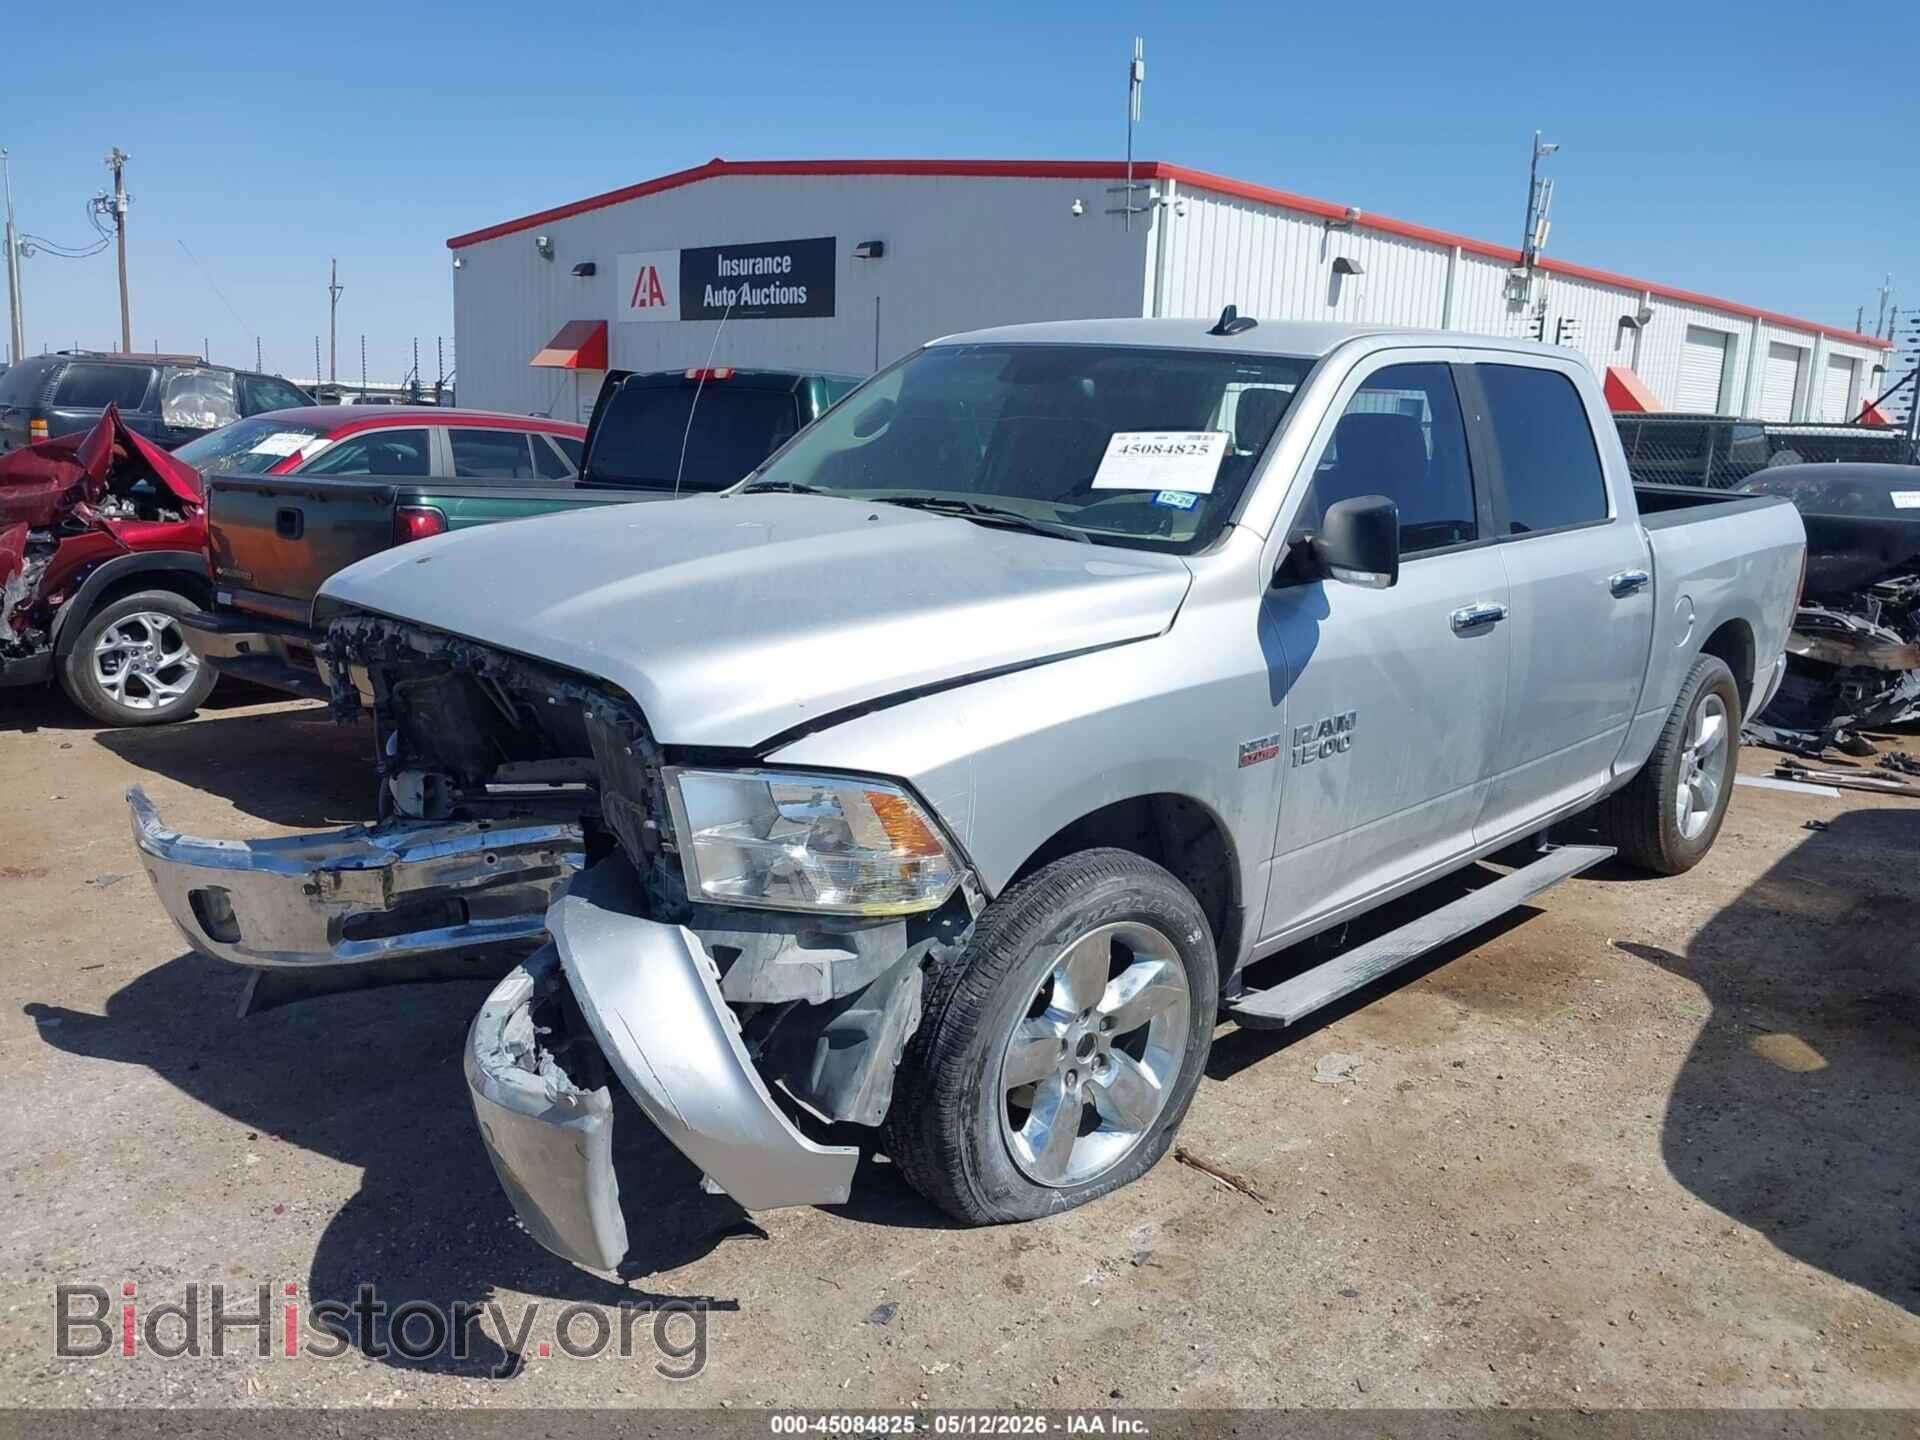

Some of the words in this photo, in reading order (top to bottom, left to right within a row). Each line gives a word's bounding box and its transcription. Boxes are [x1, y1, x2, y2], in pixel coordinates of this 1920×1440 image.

[717, 254, 792, 277] Insurance
[703, 284, 736, 307] Auto
[740, 281, 808, 306] Auctions
[1119, 443, 1209, 456] 45084825
[1293, 709, 1357, 748] RAM
